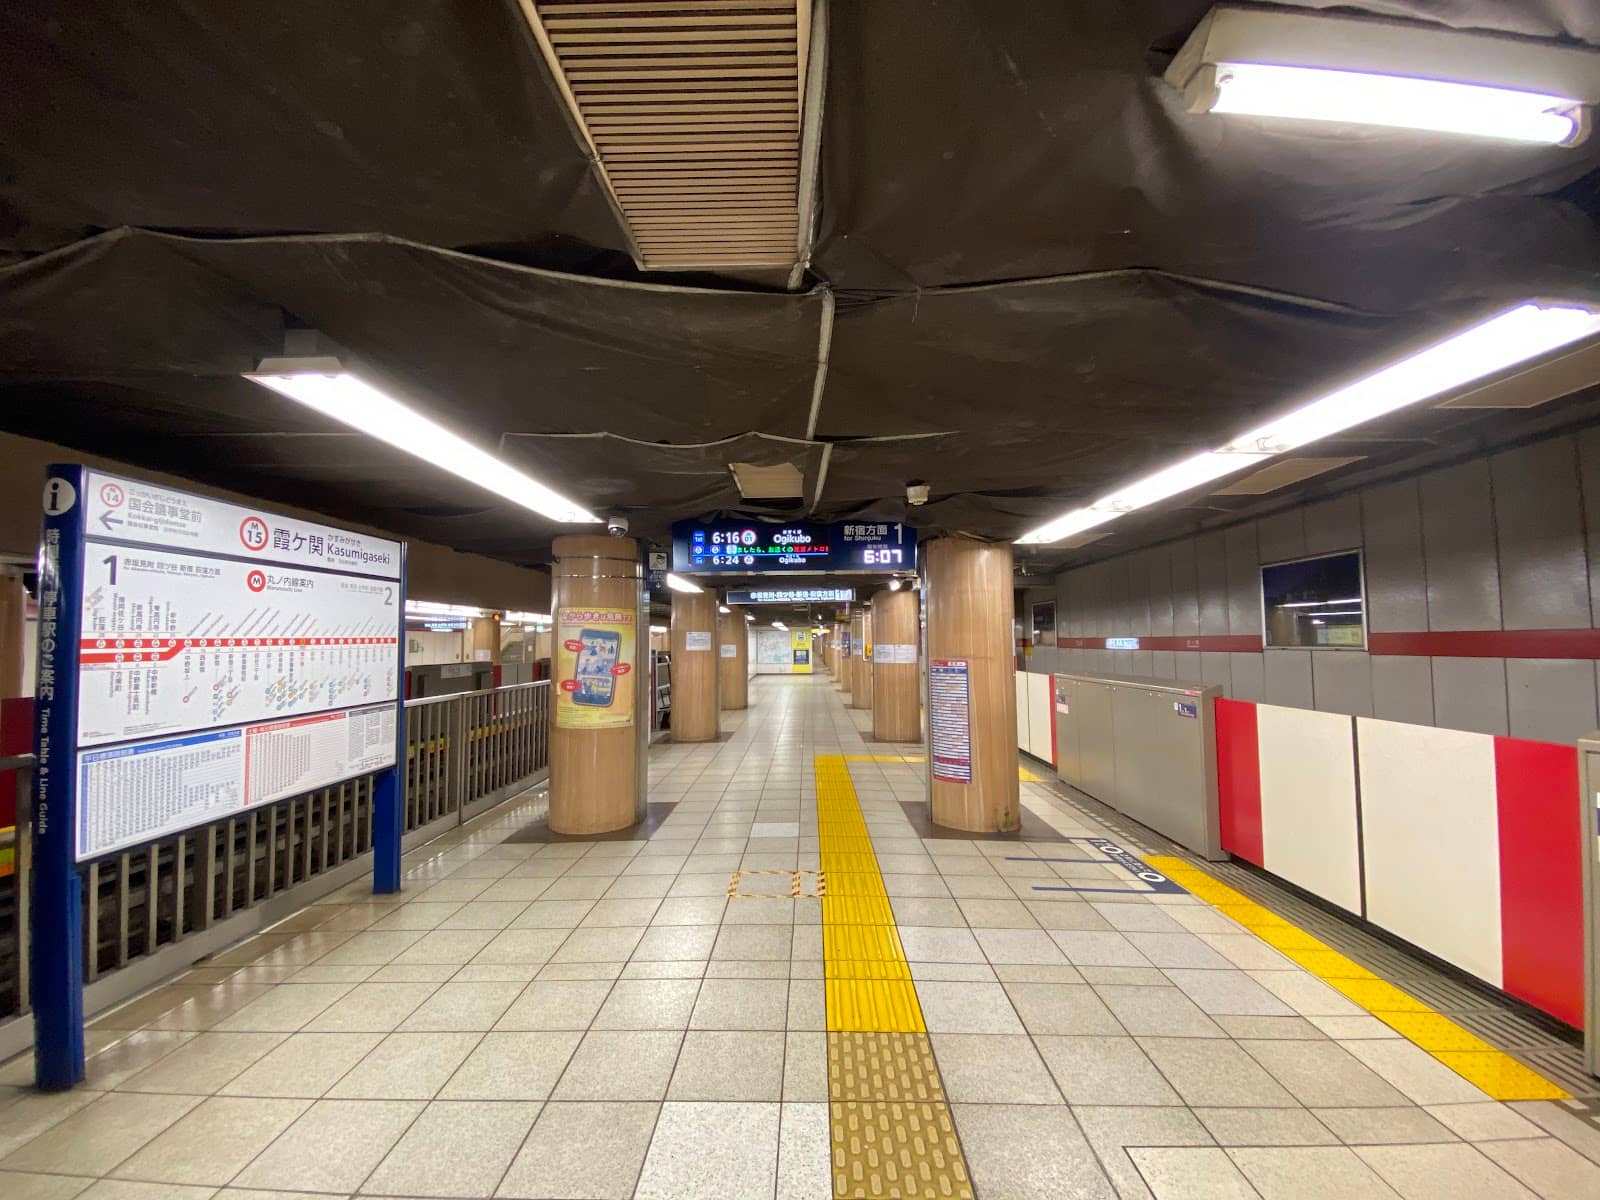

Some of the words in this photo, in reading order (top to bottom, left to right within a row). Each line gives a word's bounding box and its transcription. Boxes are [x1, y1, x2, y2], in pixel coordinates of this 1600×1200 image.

[251, 522, 259, 530] M
[843, 525, 888, 536] 新宿方面
[894, 522, 903, 545] 1
[247, 530, 263, 544] 15
[712, 531, 740, 544] 6:16
[773, 534, 811, 545] Ogikubo
[327, 543, 390, 565] Kasumigaseki
[712, 555, 740, 565] 6:24
[864, 549, 903, 564] 6:07
[103, 555, 118, 586] 1
[267, 575, 314, 589] 丸ノ内線案内
[384, 586, 393, 606] 2
[40, 707, 51, 734] Time
[39, 735, 50, 764] Table
[39, 766, 49, 775] &
[39, 776, 48, 800] Line
[38, 801, 48, 835] Guide
